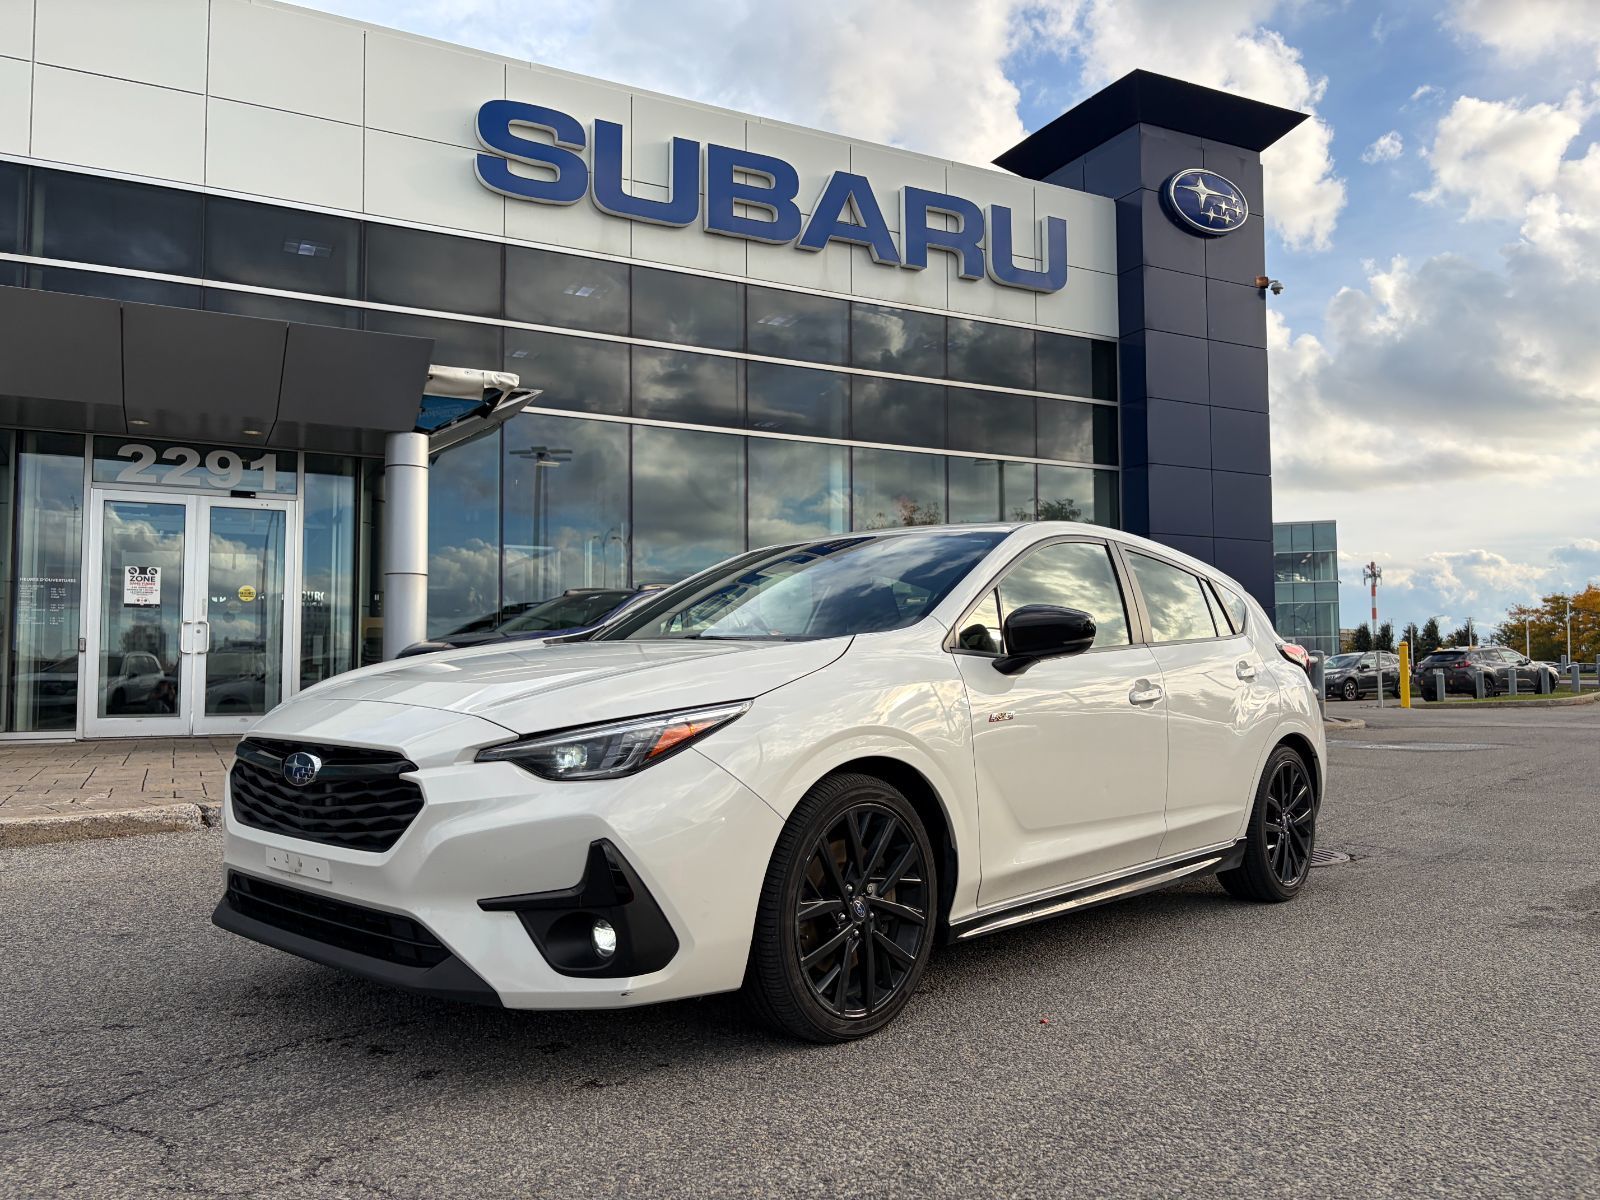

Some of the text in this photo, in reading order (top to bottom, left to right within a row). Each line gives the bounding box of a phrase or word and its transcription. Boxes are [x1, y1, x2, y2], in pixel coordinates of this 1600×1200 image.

[474, 99, 1068, 294] SUBARU
[116, 444, 278, 491] 2291
[130, 575, 156, 583] ZONE
